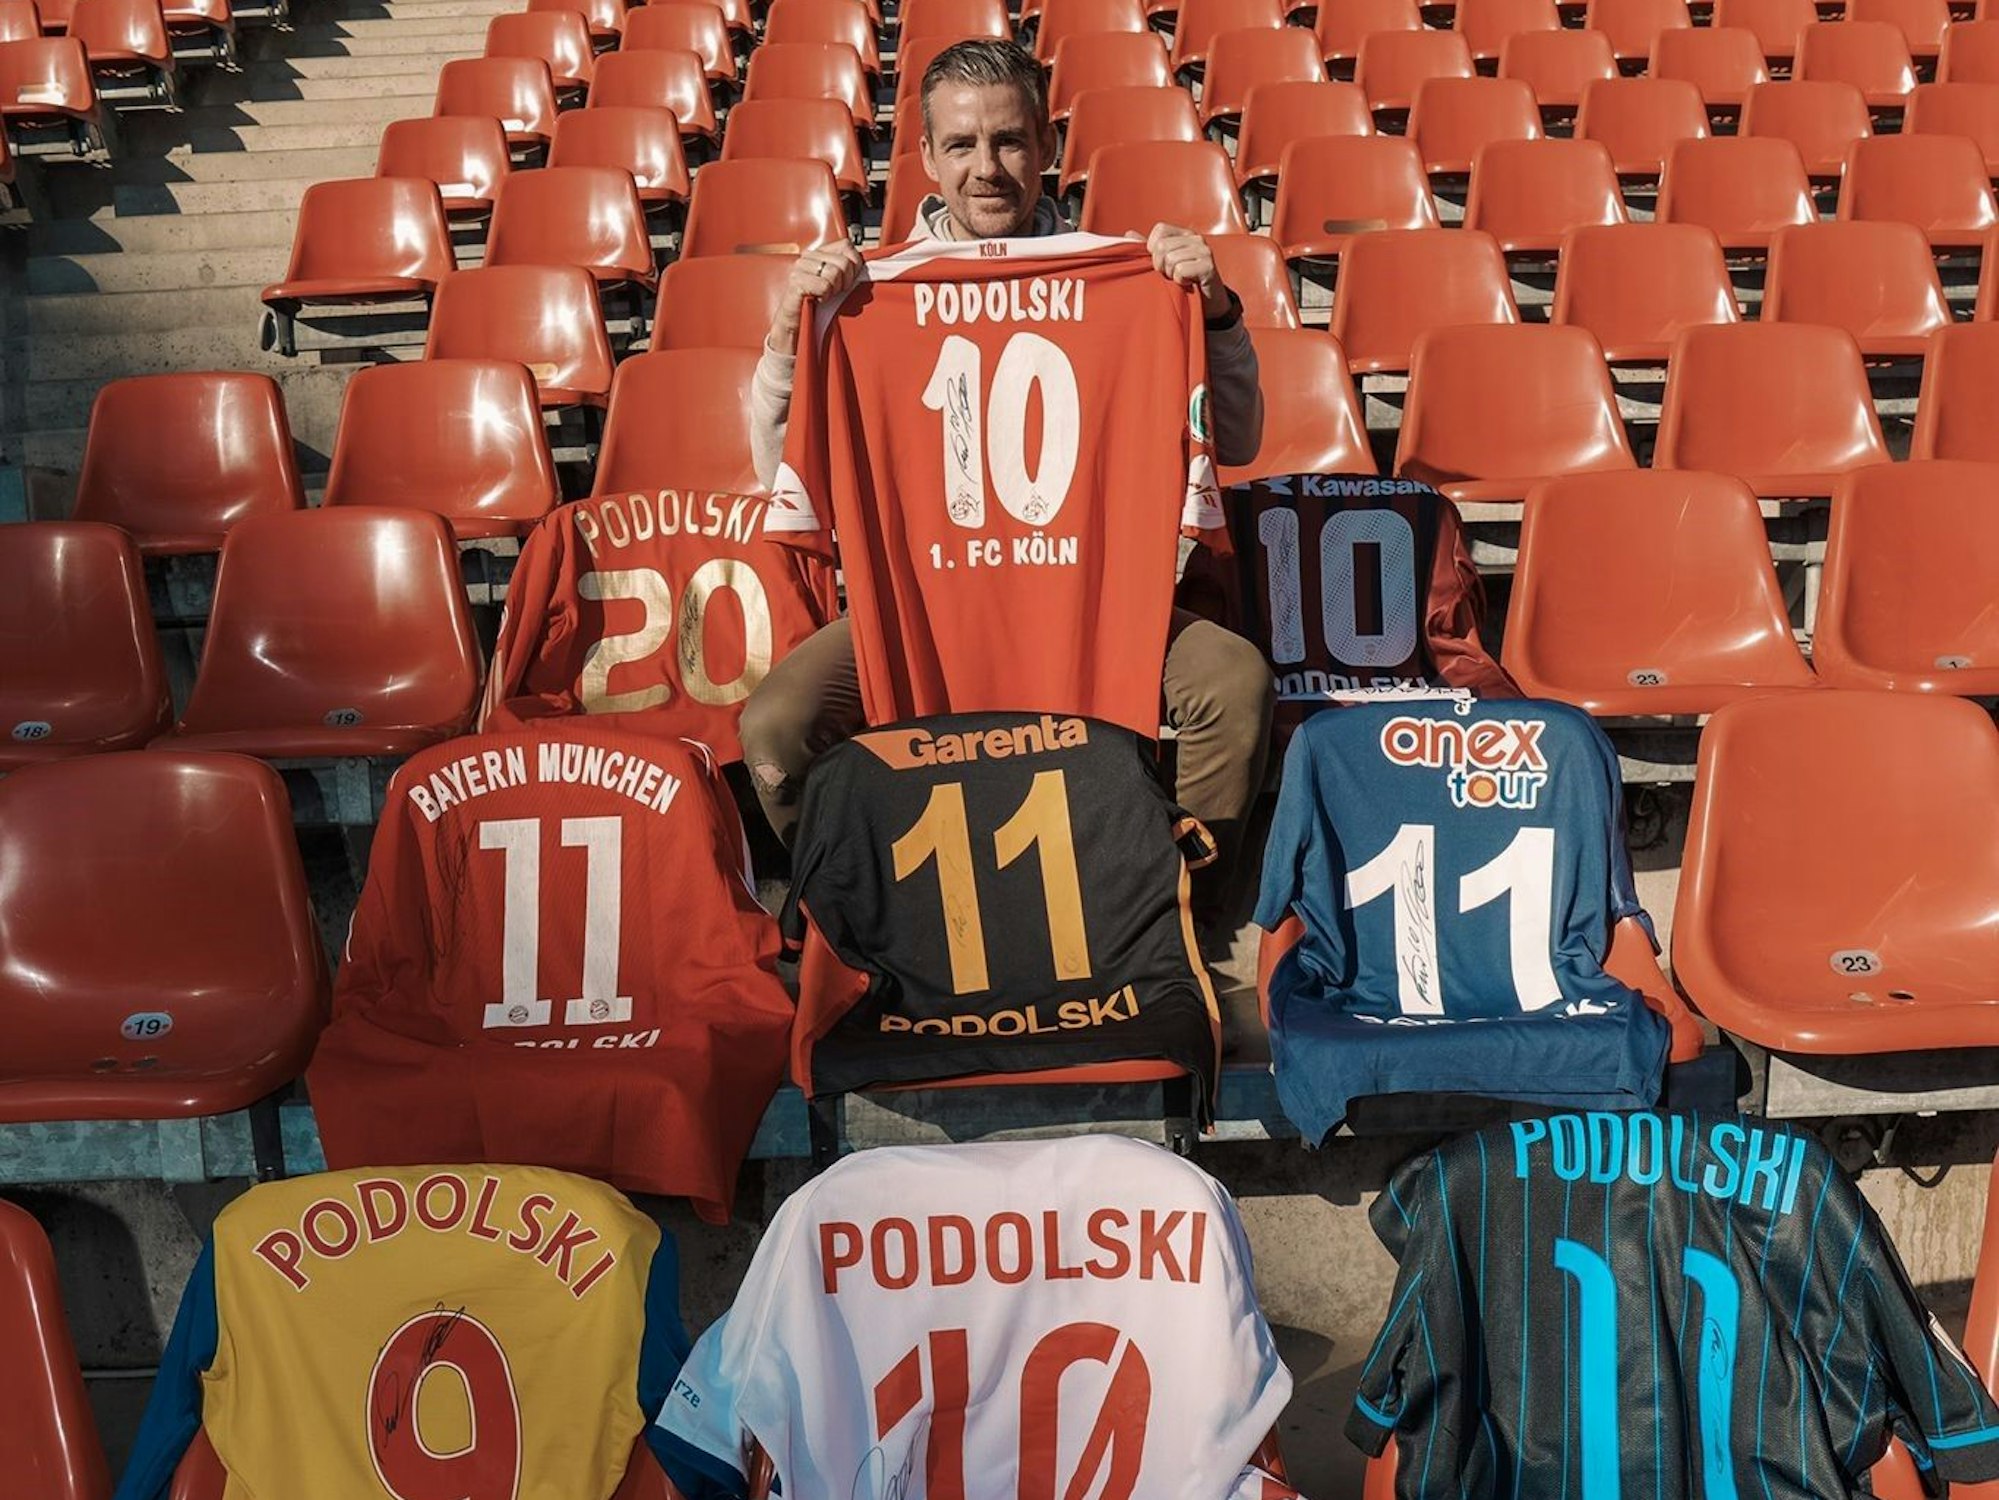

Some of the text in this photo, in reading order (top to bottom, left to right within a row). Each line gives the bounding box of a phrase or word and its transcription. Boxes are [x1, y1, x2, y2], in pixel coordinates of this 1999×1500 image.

[979, 241, 1007, 257] KÖLN
[914, 277, 1086, 327] PODOLSKI
[921, 331, 1080, 529] 10
[1301, 474, 1438, 497] Kawasak
[575, 489, 764, 559] PODOLSKI
[929, 530, 1078, 569] 1. FC KÖLN
[1258, 507, 1417, 667] 10
[577, 558, 773, 714] 20
[1636, 674, 1659, 686] 23
[23, 725, 43, 738] 18
[336, 712, 355, 725] 19
[888, 714, 1089, 770] Garenta
[1380, 717, 1548, 771] anex
[408, 742, 682, 823] BAYERN MÜNCHEN
[1447, 769, 1547, 809] tour
[891, 768, 1092, 995] 11
[479, 816, 634, 1029] 11
[1344, 823, 1563, 1016] 11
[1842, 956, 1871, 972] 23
[134, 1019, 160, 1035] 19
[880, 984, 1140, 1037] PODOLSKI
[1509, 1111, 1807, 1215] PODOLSKI
[253, 1172, 617, 1300] PODOLSKI
[819, 1206, 1207, 1295] PODOLSKI
[1554, 1238, 1742, 1500] 11
[365, 1309, 523, 1500] 9
[874, 1321, 1152, 1500] 10
